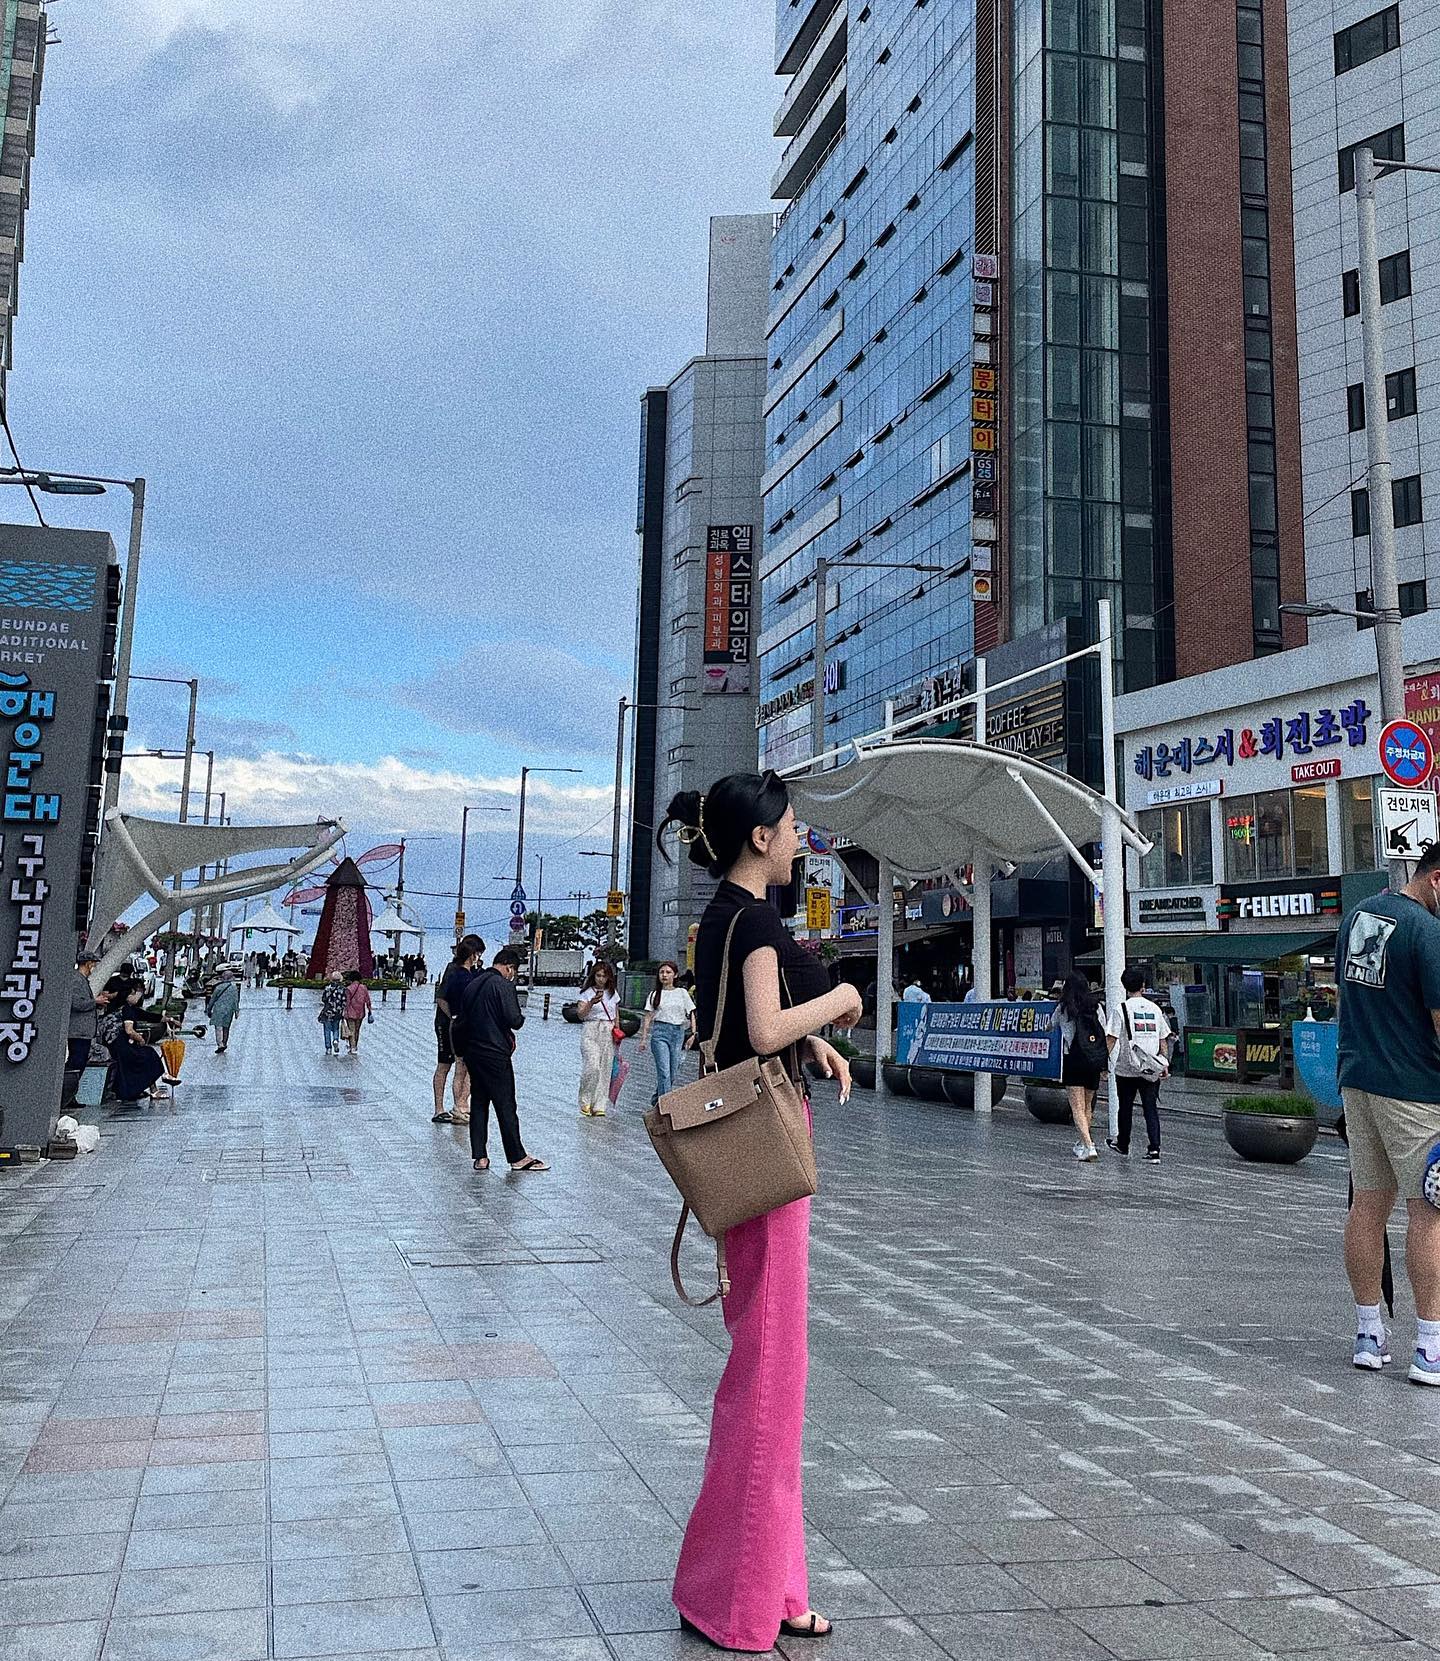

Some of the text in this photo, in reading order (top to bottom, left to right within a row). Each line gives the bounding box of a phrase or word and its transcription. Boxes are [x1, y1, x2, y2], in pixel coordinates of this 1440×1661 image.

[977, 459, 992, 469] GS
[977, 469, 992, 479] 25
[989, 705, 1026, 735] COFFEE
[1386, 746, 1425, 761] 주정차금지
[1294, 760, 1336, 780] TAKE OUT
[1387, 797, 1430, 813] 견인지역
[1046, 931, 1064, 943] HOTEL
[0, 835, 49, 1062] 구남로광장
[1245, 1045, 1281, 1062] WAY
